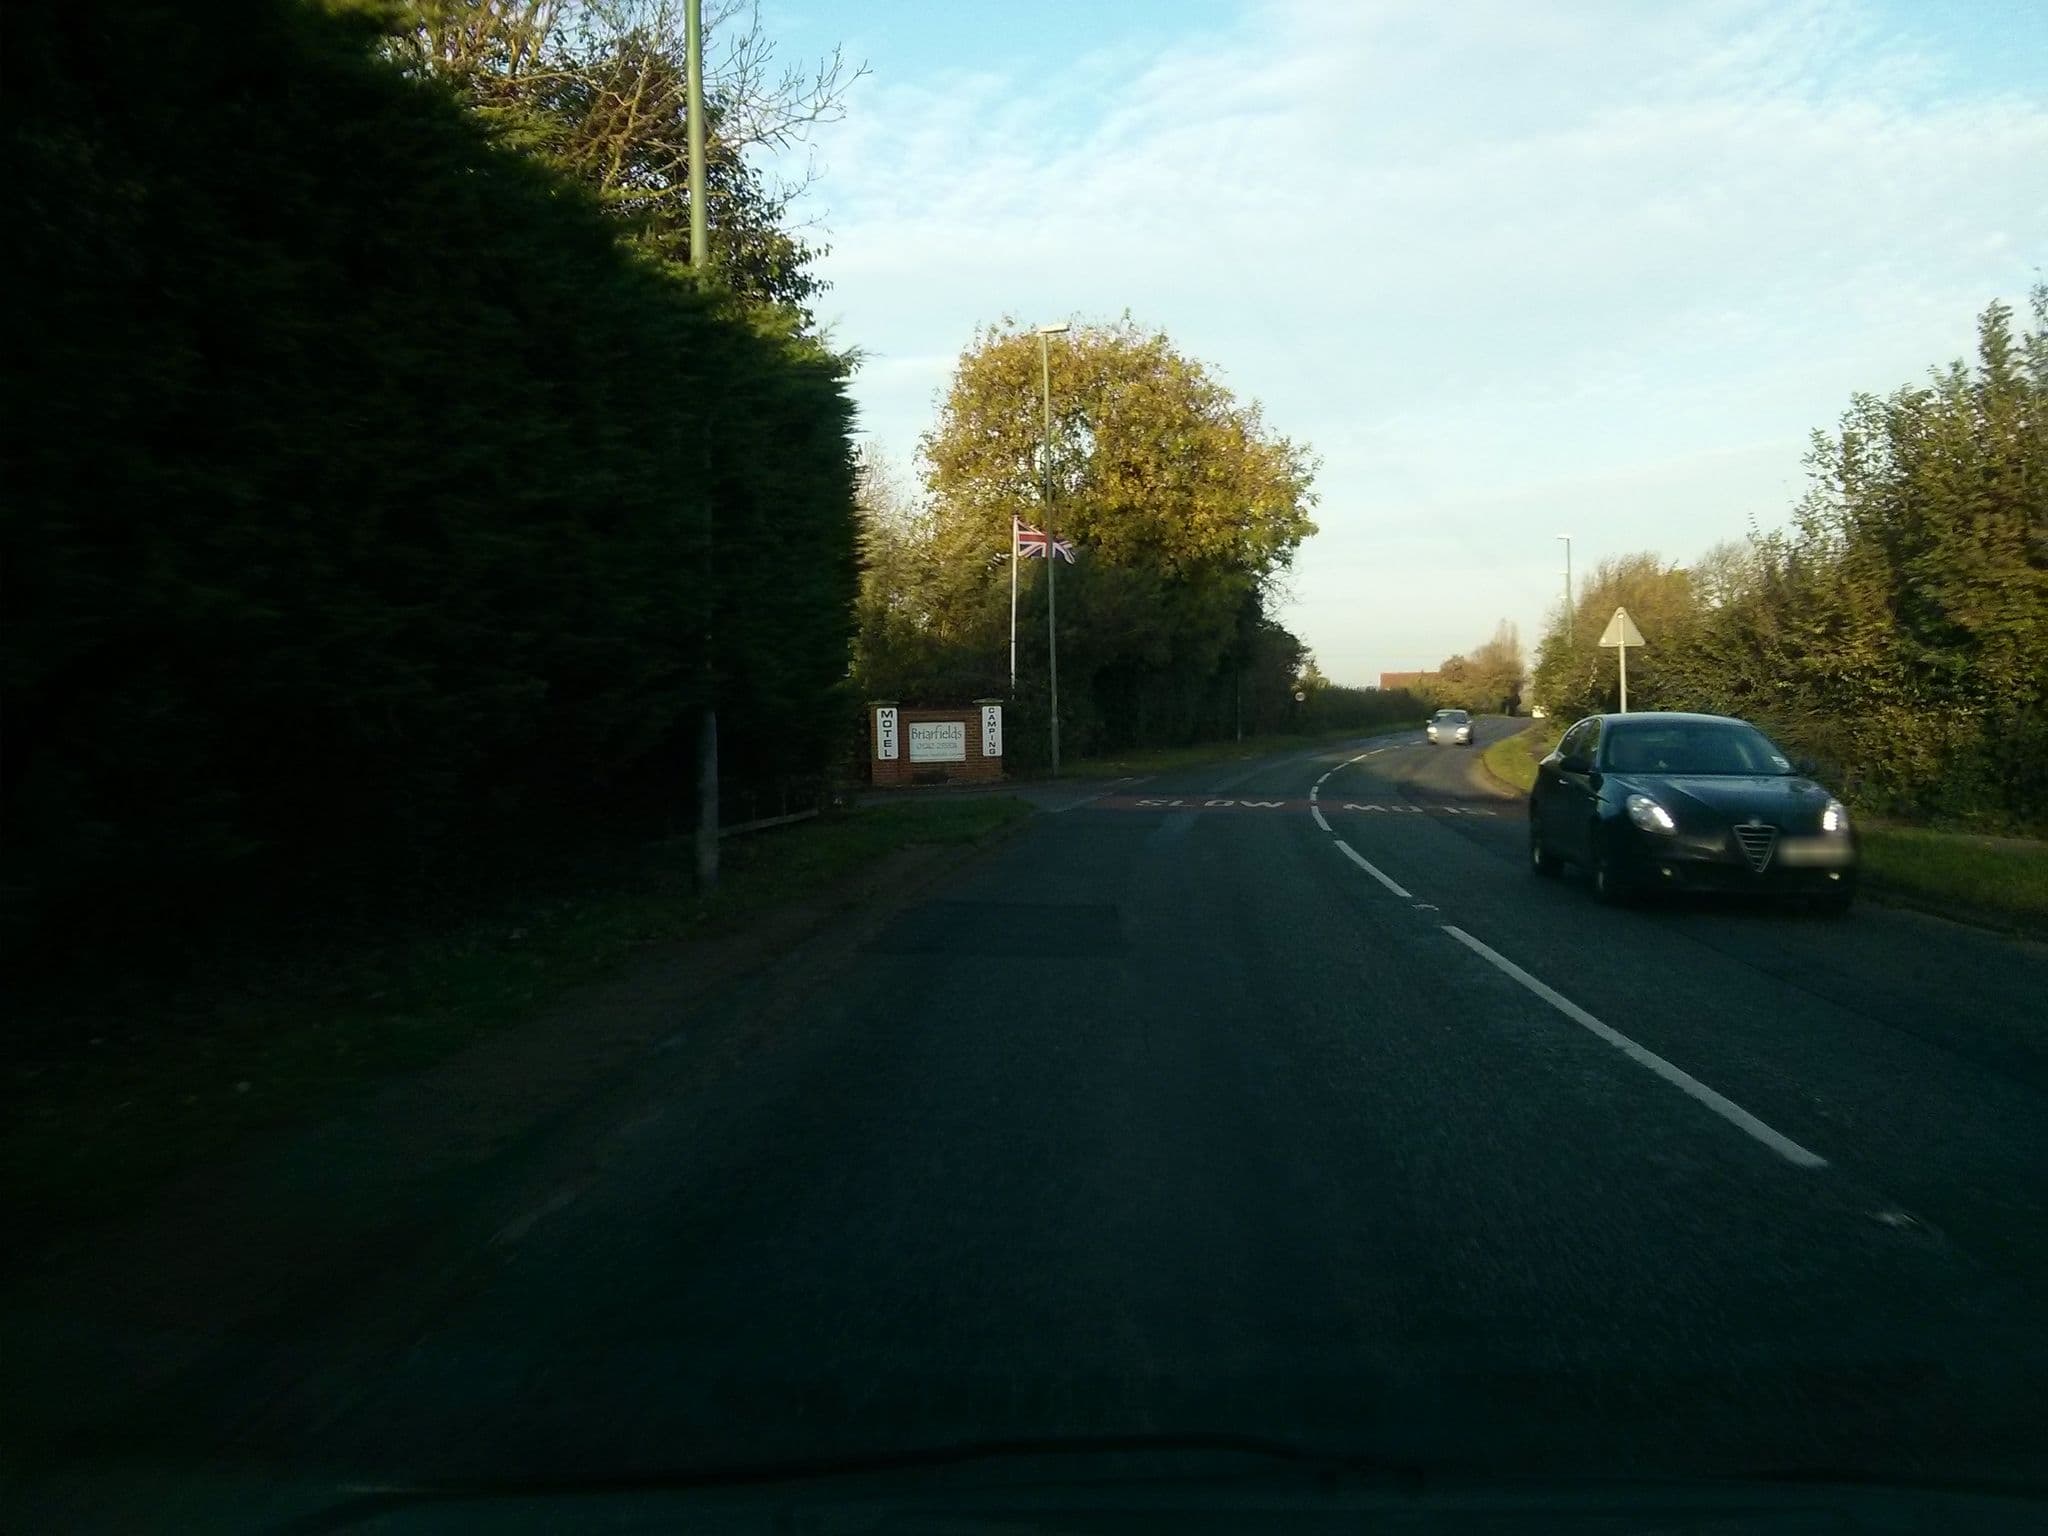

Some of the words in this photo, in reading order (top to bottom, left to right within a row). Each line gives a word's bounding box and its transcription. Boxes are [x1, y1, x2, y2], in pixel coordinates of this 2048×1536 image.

[881, 710, 893, 757] MOTEL
[911, 725, 962, 740] Briarfields
[988, 708, 997, 754] CAMPING
[1135, 799, 1286, 808] SLOW
